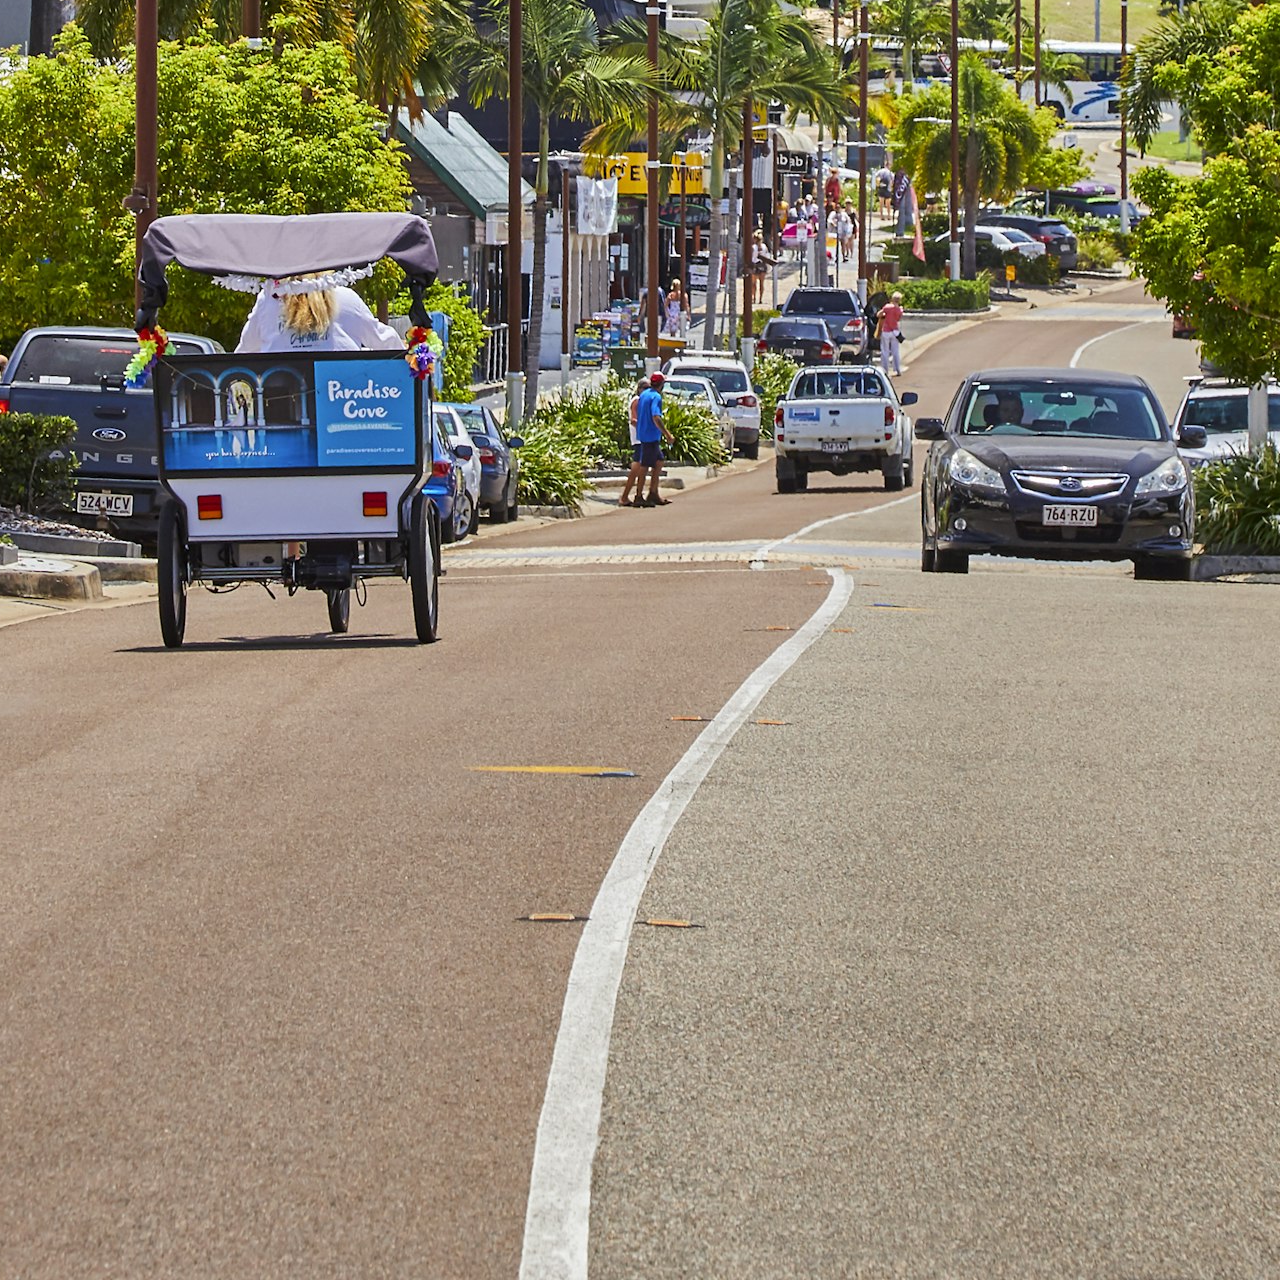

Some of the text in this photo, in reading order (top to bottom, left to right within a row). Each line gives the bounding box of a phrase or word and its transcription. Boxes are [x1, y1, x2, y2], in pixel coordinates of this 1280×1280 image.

[327, 379, 402, 402] Paradise
[343, 400, 388, 419] Cove
[99, 430, 119, 439] Ford
[326, 447, 405, 455] paradisecoveresort.com.au
